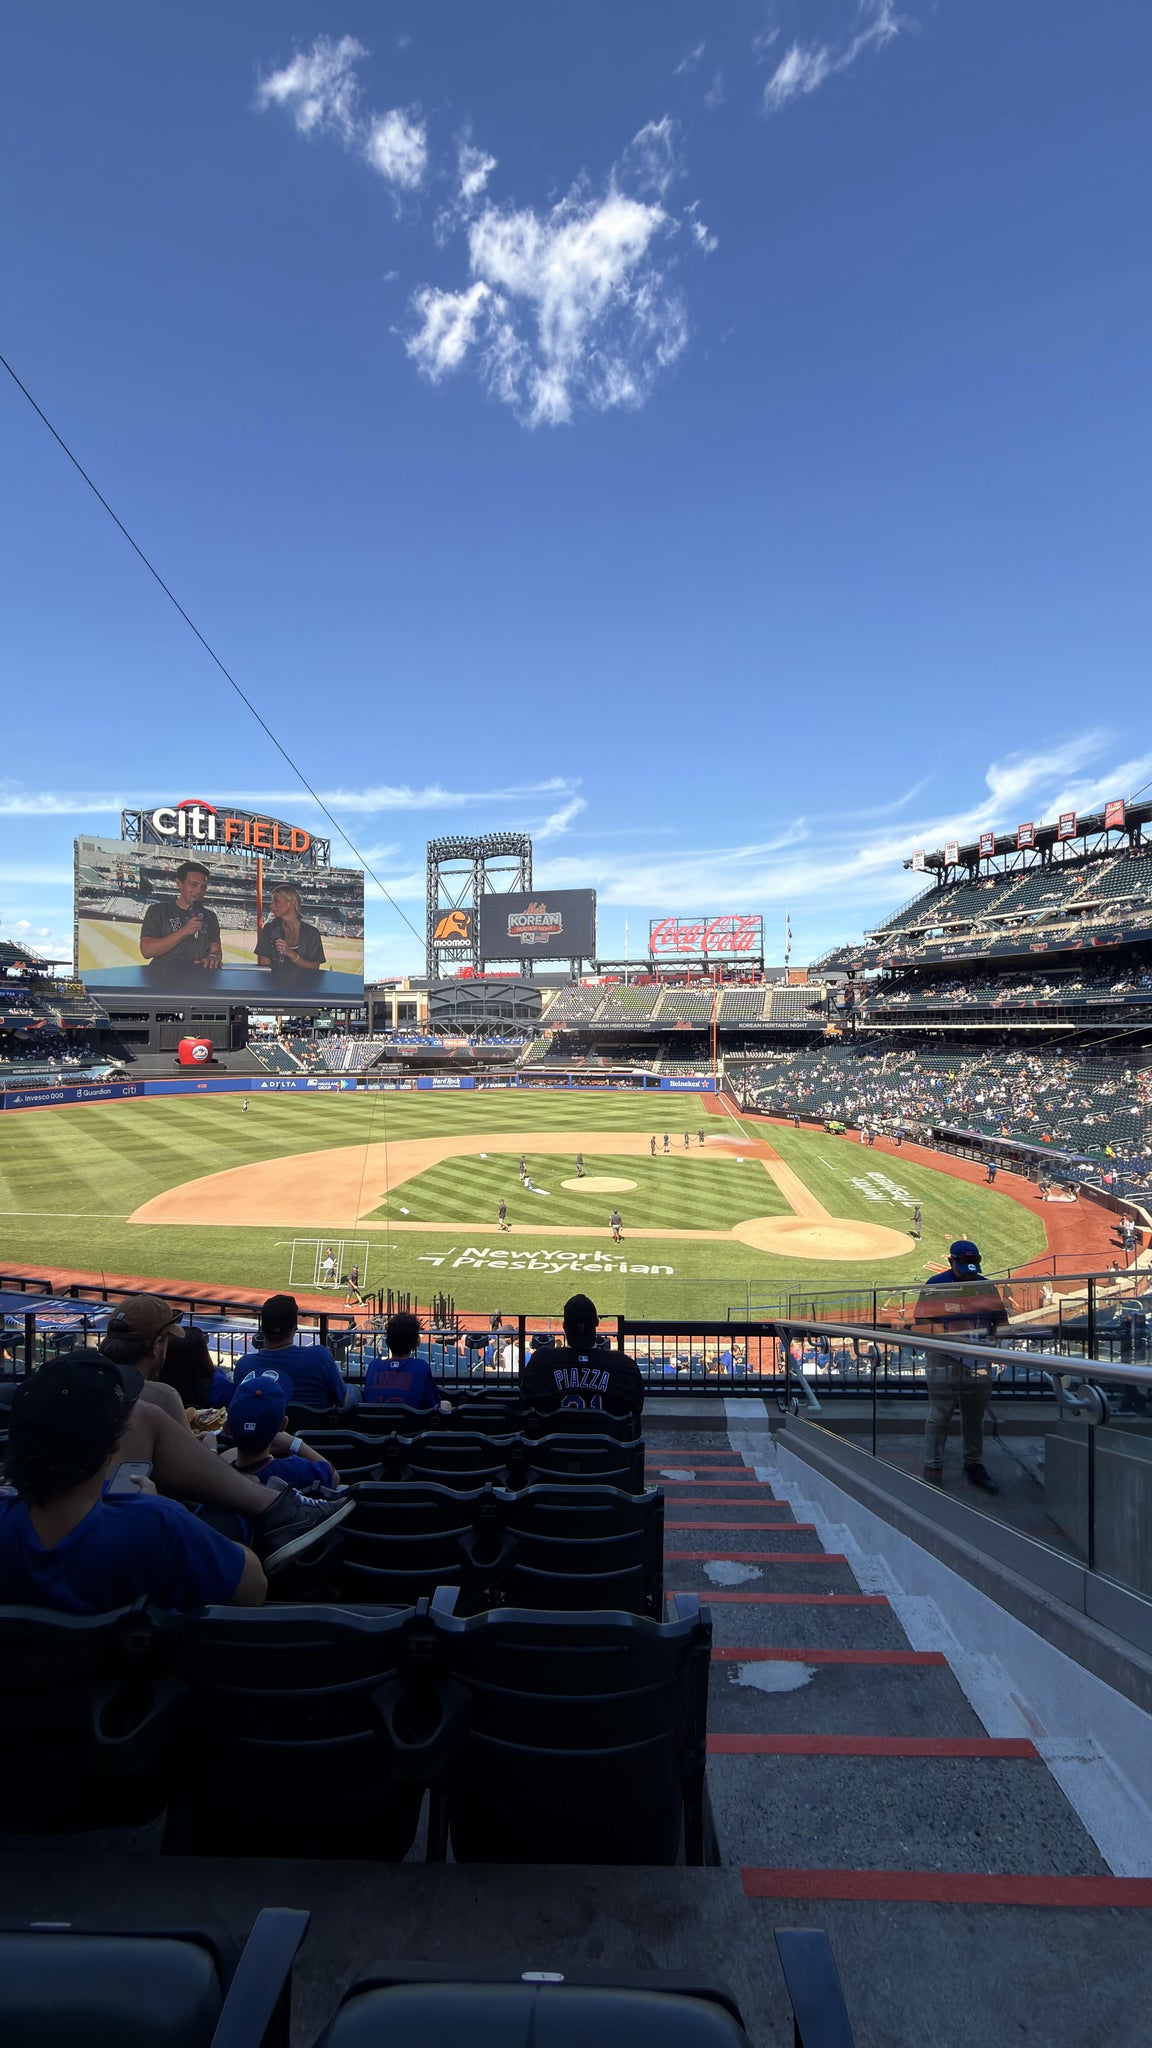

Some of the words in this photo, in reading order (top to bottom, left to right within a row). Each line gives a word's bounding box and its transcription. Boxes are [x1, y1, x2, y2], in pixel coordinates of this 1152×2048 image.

[152, 804, 216, 840] citi
[225, 818, 310, 852] FIELD
[510, 915, 560, 926] KOREAN
[650, 915, 763, 953] Coca-Cola
[434, 939, 471, 948] moomoo
[83, 1088, 112, 1096] Guardian
[122, 1085, 137, 1095] citi
[25, 1094, 50, 1102] Invesco
[462, 1247, 624, 1262] NewYork-
[452, 1257, 674, 1275] Presbyterian
[554, 1368, 610, 1393] PIAZZA
